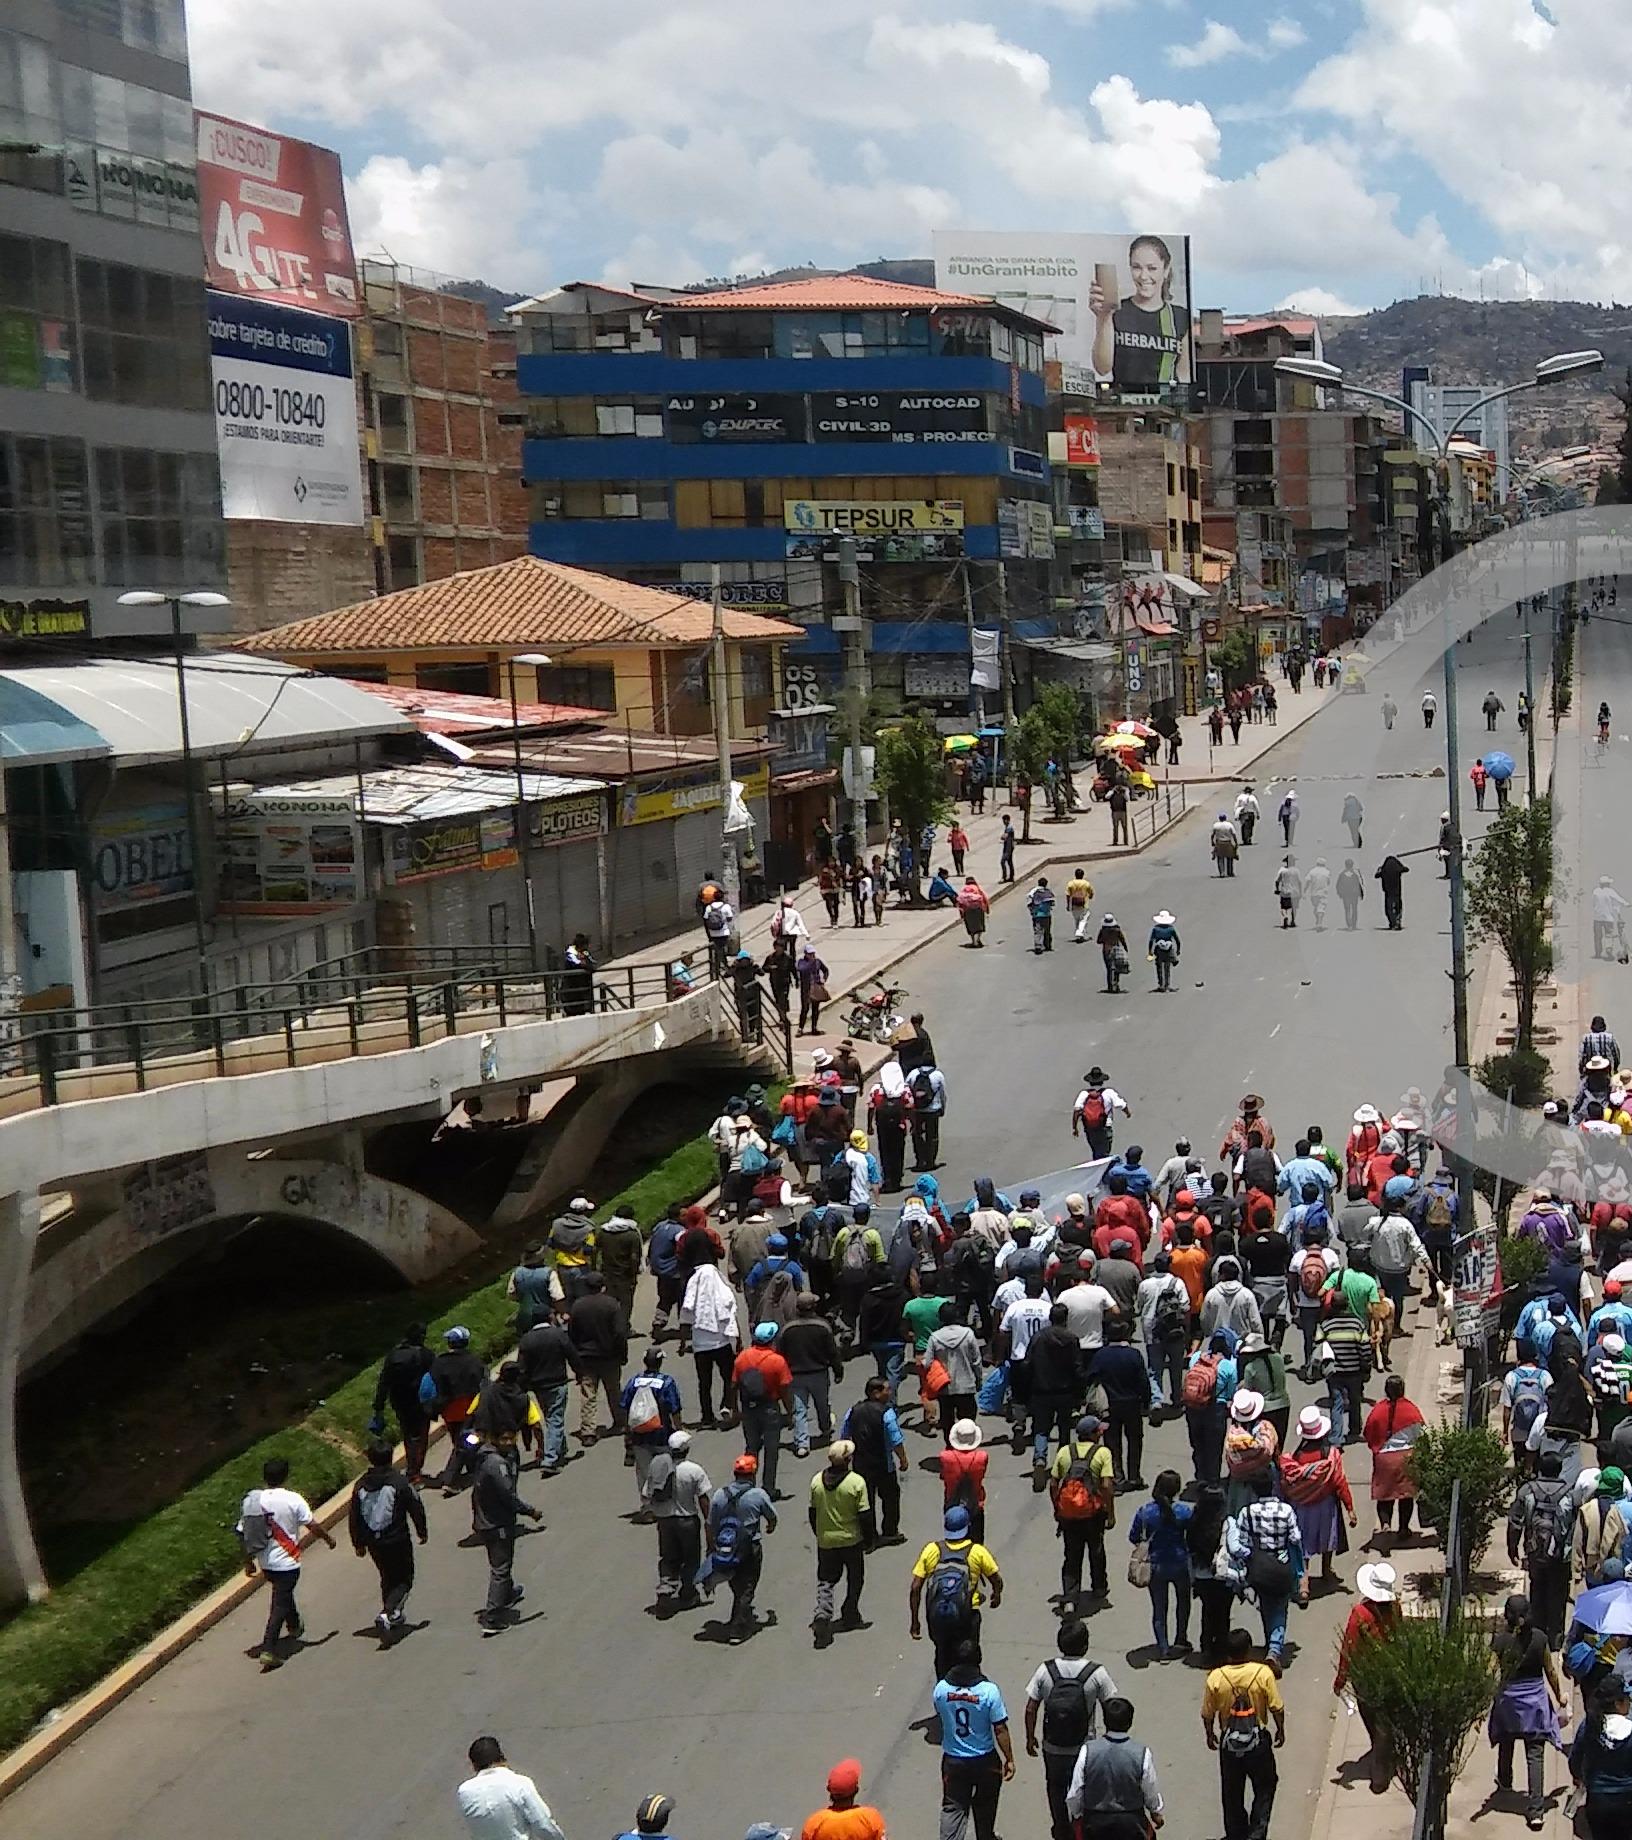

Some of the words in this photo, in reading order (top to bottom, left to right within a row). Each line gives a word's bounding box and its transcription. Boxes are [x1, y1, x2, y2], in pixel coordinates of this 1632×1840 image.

[239, 323, 275, 350] tarjeta
[277, 327, 292, 352] de
[216, 379, 325, 429] 0800-10840
[899, 397, 981, 410] AUTOCAD
[260, 426, 280, 442] PARA
[818, 420, 867, 432] CIVIL
[868, 421, 892, 432] 3D
[891, 431, 916, 444] MS
[819, 508, 915, 529] TEPSUR
[541, 807, 600, 834] PLOTEOS
[1025, 1317, 1041, 1338] 10
[955, 1707, 971, 1738] 9
